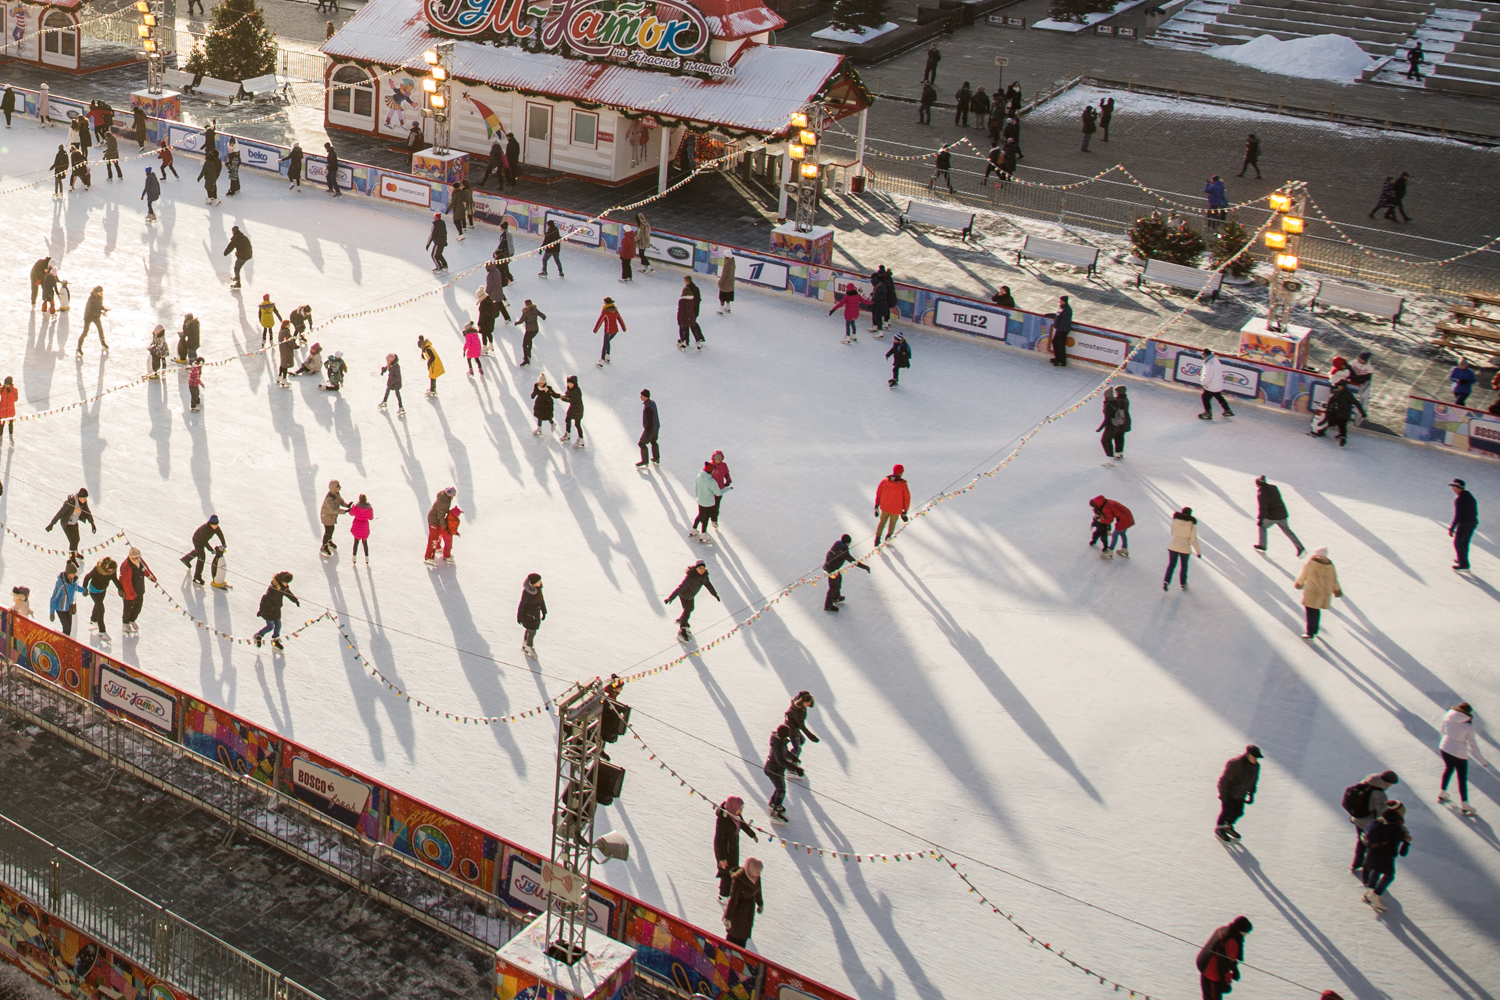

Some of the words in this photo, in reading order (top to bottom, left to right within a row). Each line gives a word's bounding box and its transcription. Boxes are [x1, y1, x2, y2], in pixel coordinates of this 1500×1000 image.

[613, 49, 628, 59] на
[630, 50, 680, 68] Красной
[684, 60, 737, 75] площади
[248, 148, 268, 161] beko
[398, 187, 425, 197] mastercard
[953, 313, 988, 329] TELE2
[1077, 340, 1119, 355] mastercard
[298, 769, 326, 794] BOSCO
[328, 793, 359, 813] fresh
